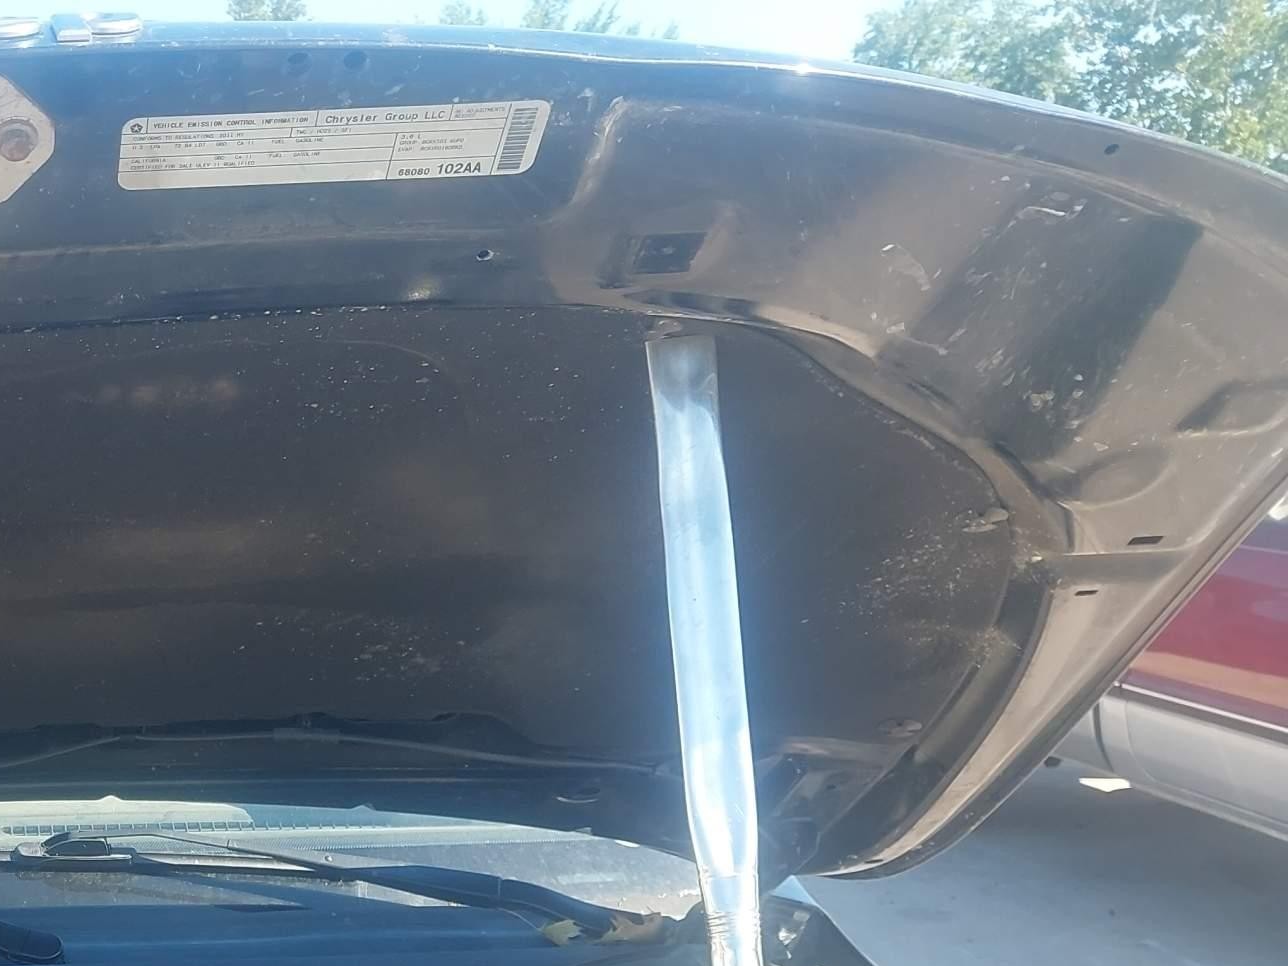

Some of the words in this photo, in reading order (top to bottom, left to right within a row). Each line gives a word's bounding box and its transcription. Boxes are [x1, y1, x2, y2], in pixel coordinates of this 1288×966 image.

[187, 120, 223, 128] EMISSION
[261, 117, 309, 126] INFORMATION
[325, 113, 378, 125] Chrysler
[385, 111, 419, 123] Group
[424, 110, 446, 119] LLC
[398, 167, 431, 177] 68080
[437, 162, 481, 175] 102AA
